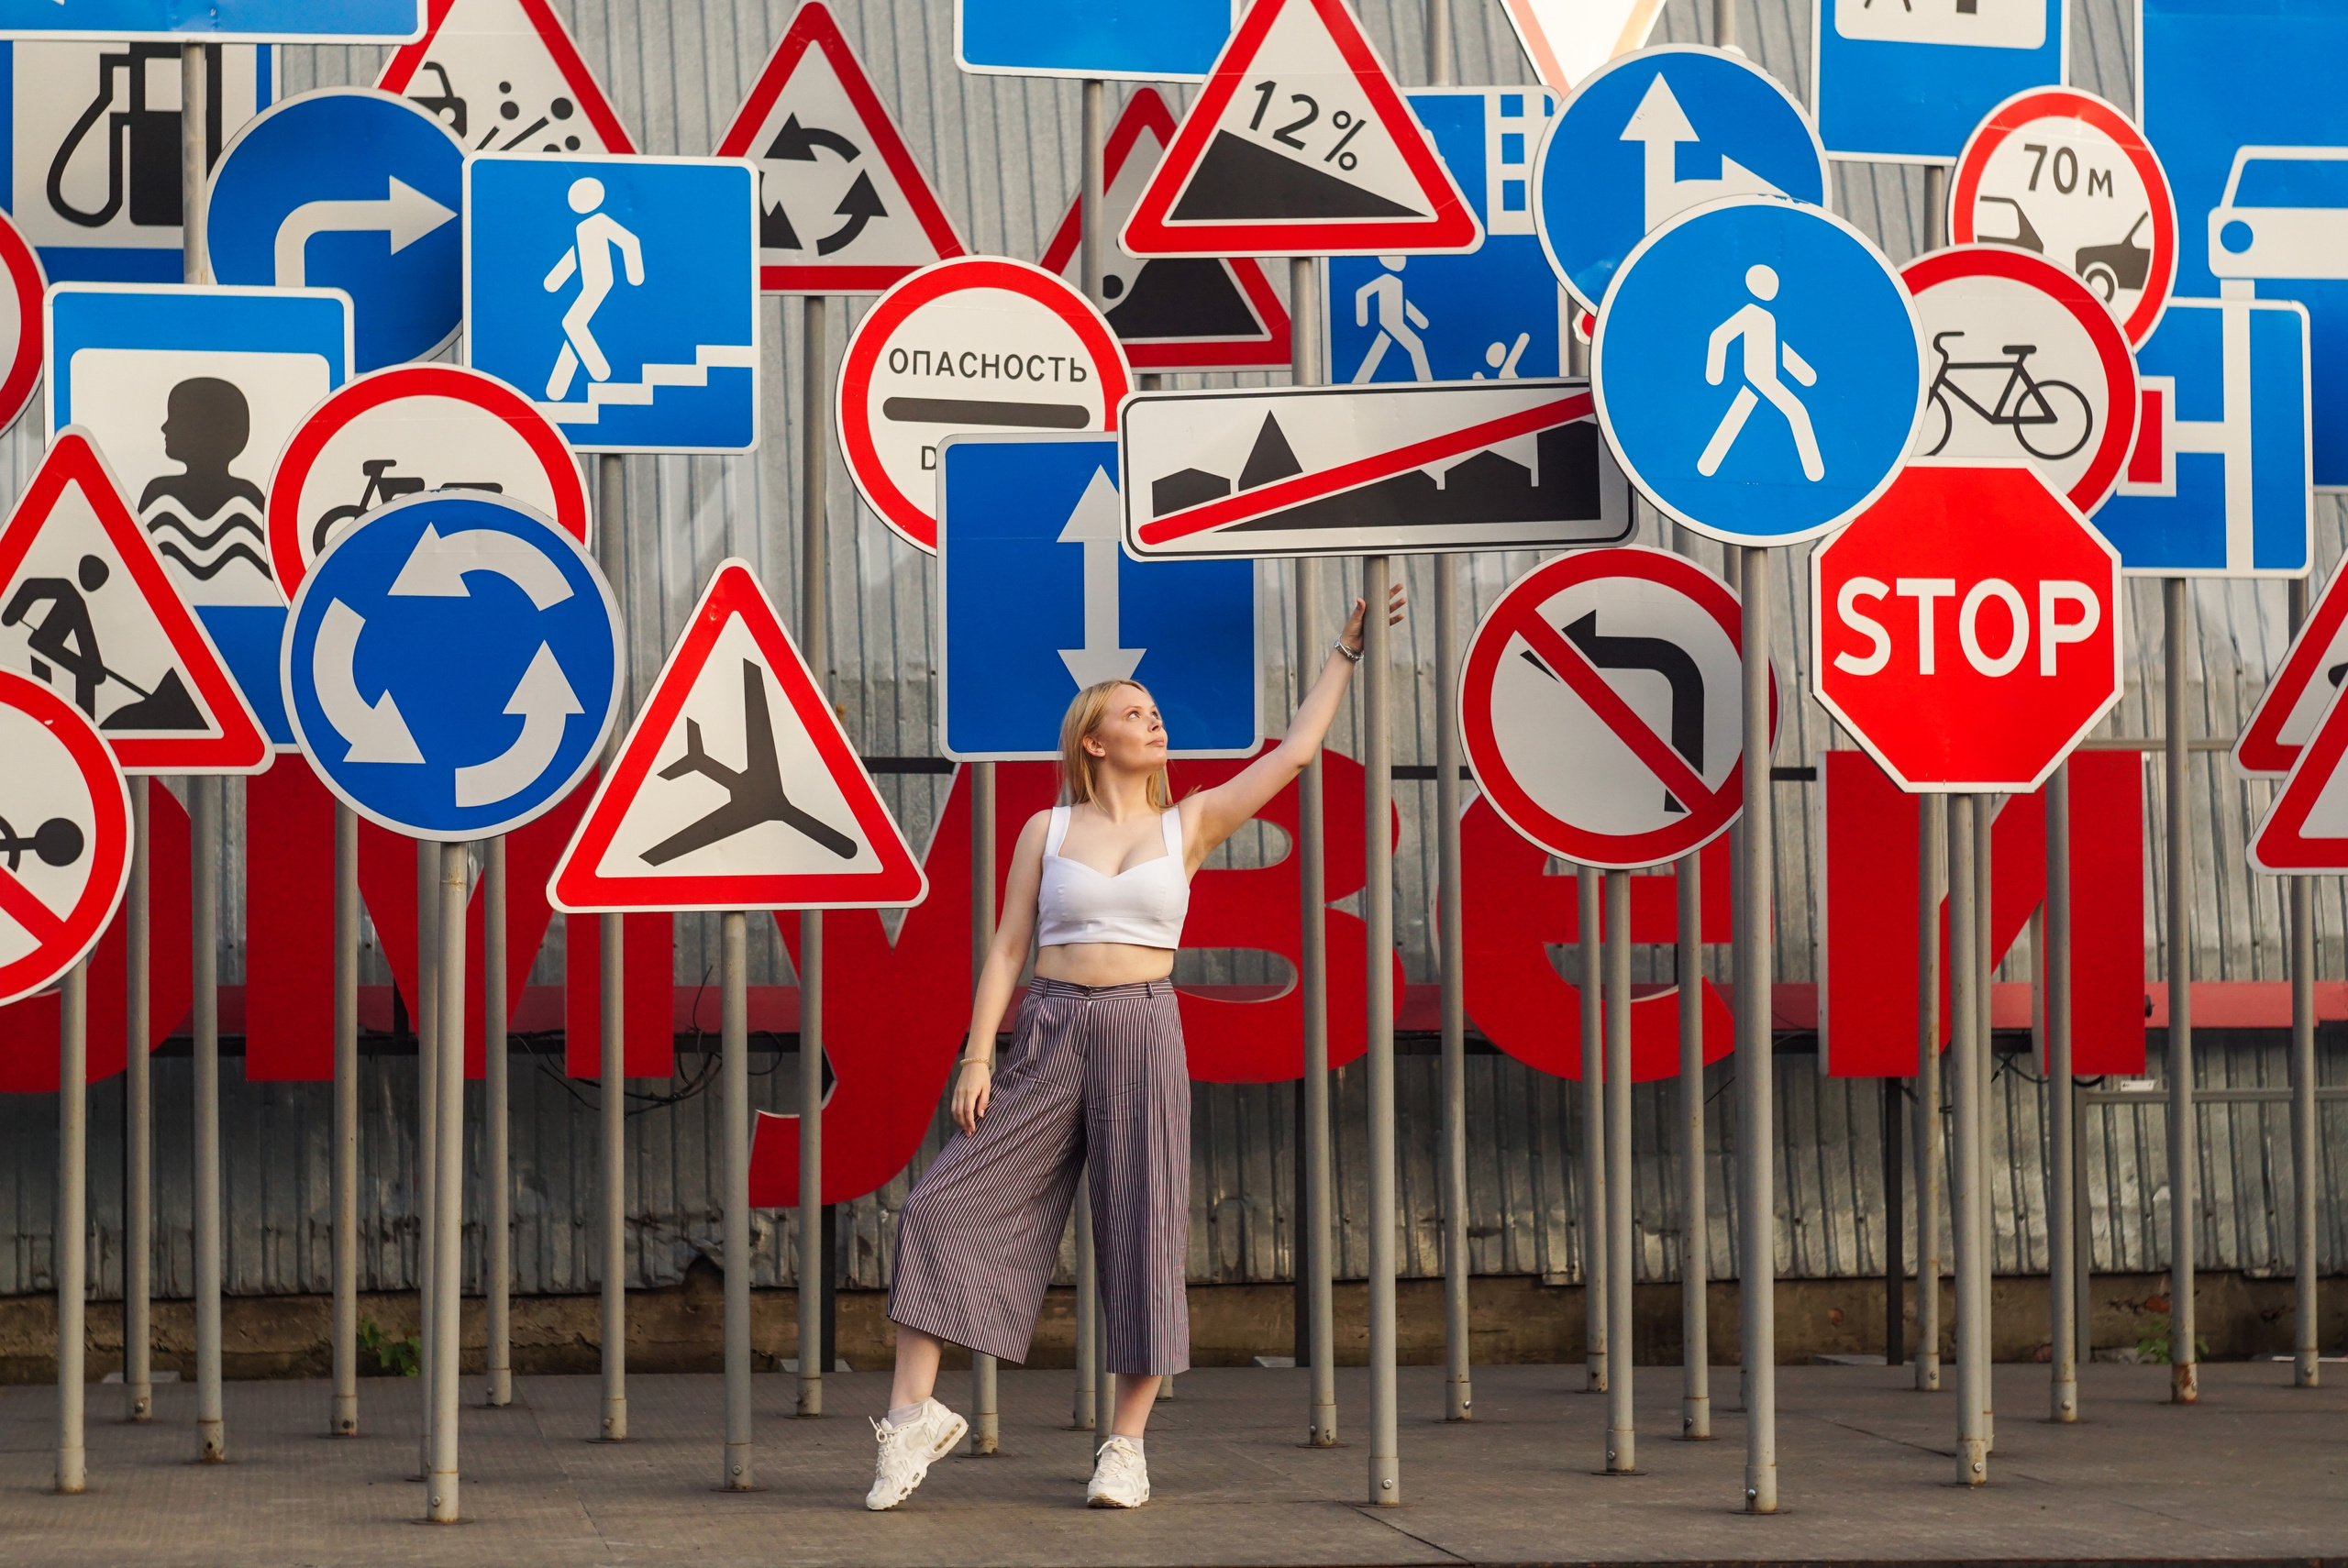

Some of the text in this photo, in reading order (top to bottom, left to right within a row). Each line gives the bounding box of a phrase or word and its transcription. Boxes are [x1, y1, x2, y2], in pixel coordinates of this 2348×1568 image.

[1248, 80, 1367, 171] 12%
[2023, 143, 2078, 195] 70
[888, 348, 1088, 382] ОПАСНОСТЬ
[1833, 576, 2101, 678] STOP
